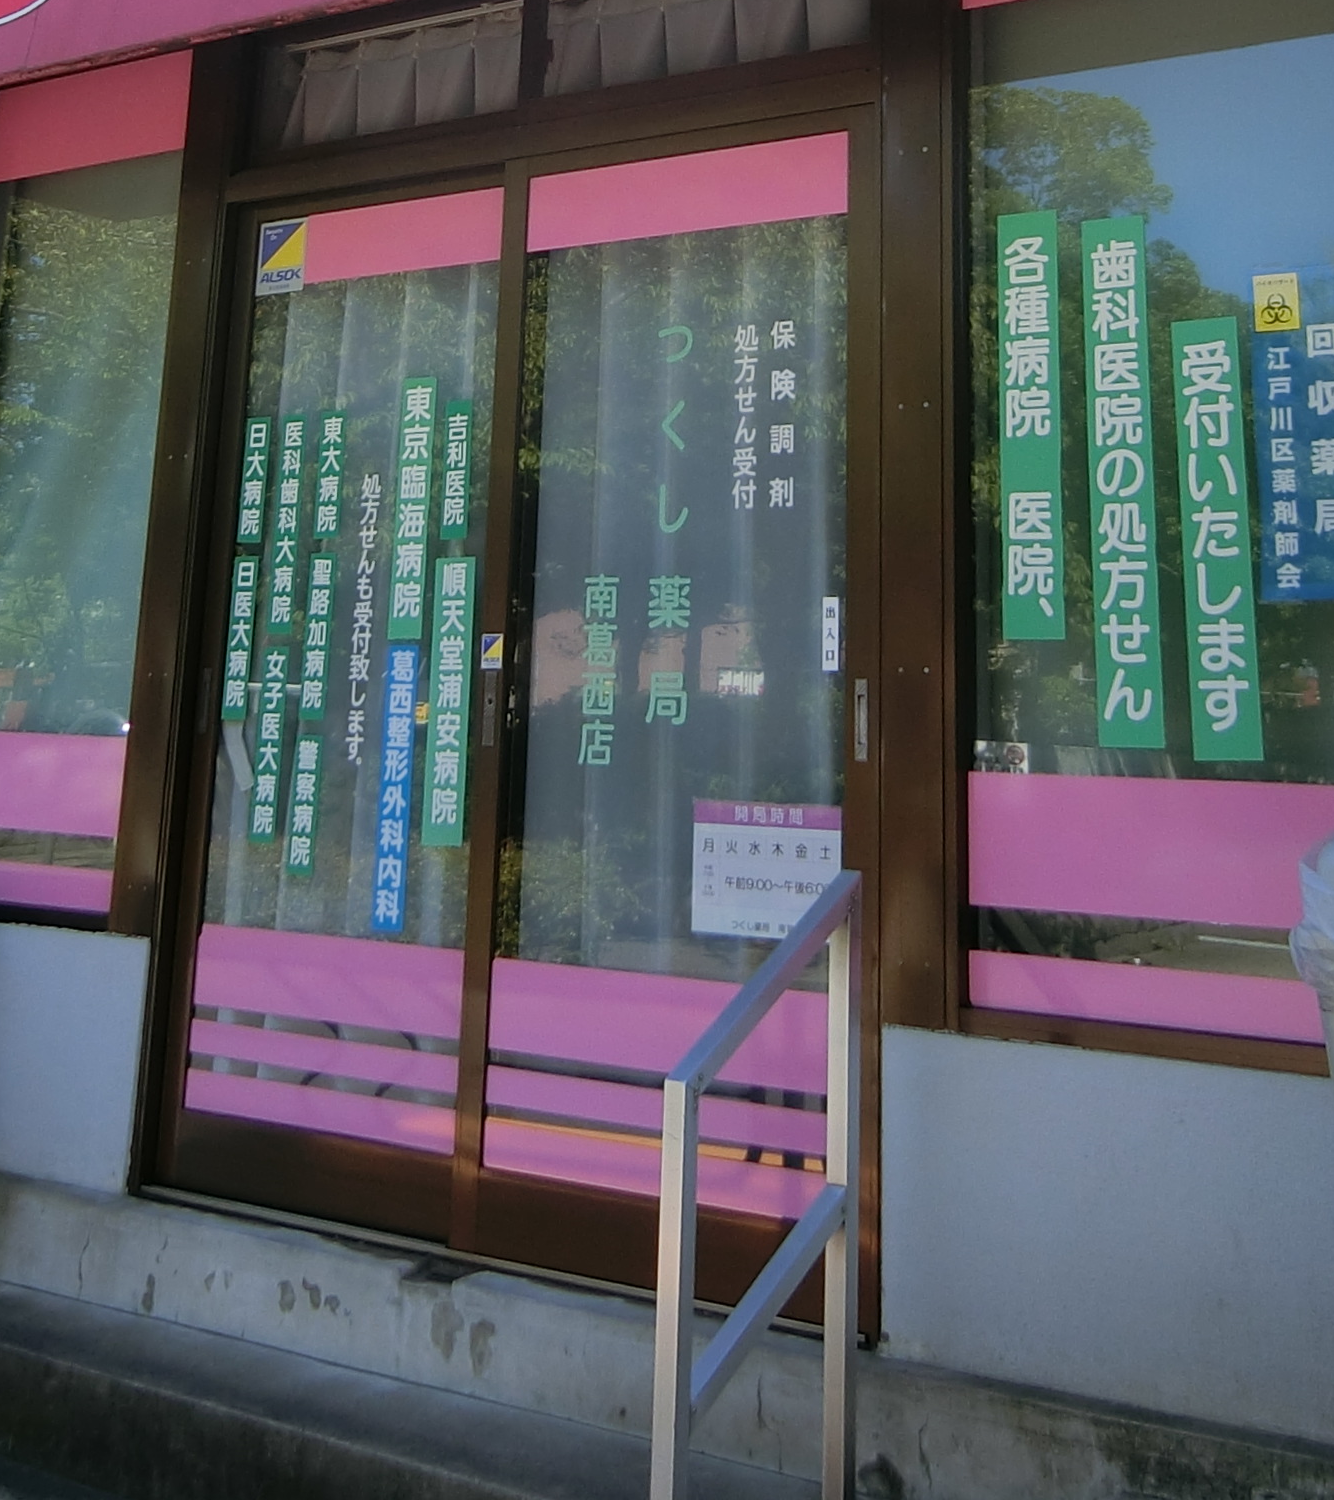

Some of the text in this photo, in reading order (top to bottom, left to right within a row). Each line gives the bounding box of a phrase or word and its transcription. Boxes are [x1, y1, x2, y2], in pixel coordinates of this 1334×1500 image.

[259, 268, 302, 284] ALSOK
[239, 423, 268, 536] 日大病院
[316, 416, 343, 533] 東大病院
[392, 385, 433, 619] 東京臨海病院
[443, 412, 469, 526] 吉利医院
[731, 324, 759, 510] 処方せん受付
[768, 320, 796, 509] 保険調剤
[1004, 236, 1055, 618] 各種病院 医院、
[1090, 239, 1153, 723] 歯科医院の処方せん
[1266, 346, 1302, 590] 江戸川区薬剤師会
[270, 421, 304, 623] 医科歯科大病院
[644, 325, 694, 726] つくし薬局
[1180, 339, 1249, 732] 受付いたします
[224, 561, 255, 708] 日医大病院
[301, 558, 333, 709] 聖路加病院
[345, 473, 382, 766] 処方せんも受付致します。
[431, 561, 469, 826] 順天堂浦安病院
[577, 573, 620, 765] 南葛西店
[824, 605, 836, 663] 出入口
[252, 651, 287, 834] 女子医大病院
[289, 739, 319, 866] 警察病院
[375, 649, 417, 925] 葛西整形外科内科
[734, 805, 804, 825] 開局時間
[702, 838, 832, 860] 月 火 水 木 金 土
